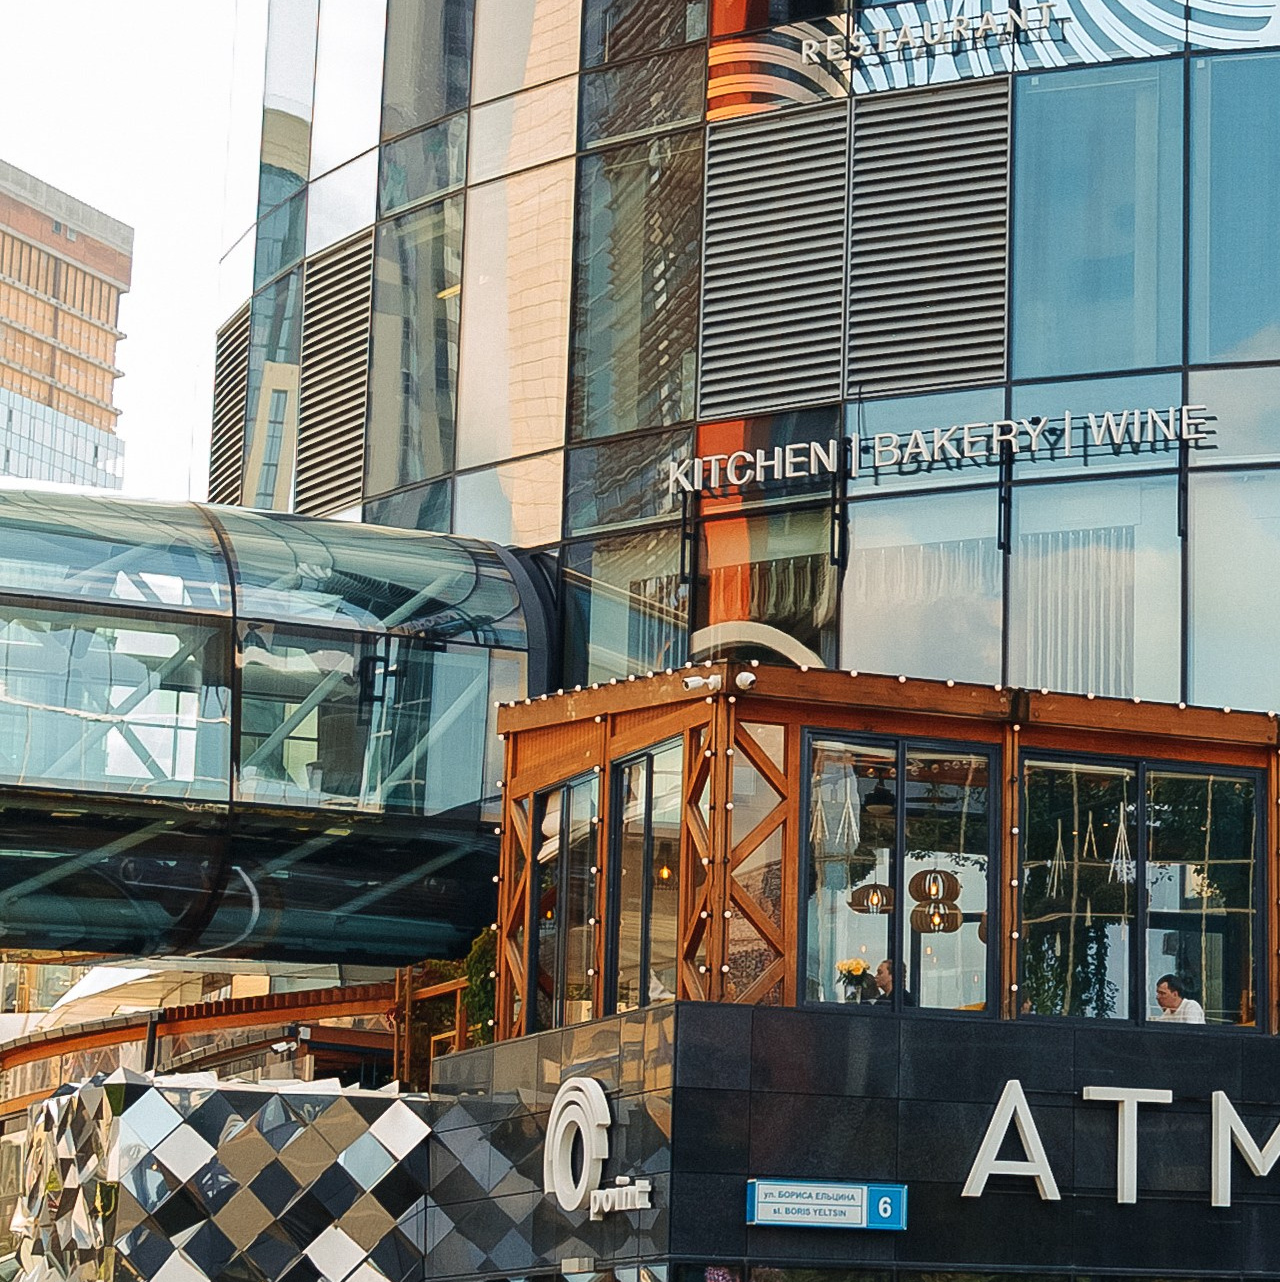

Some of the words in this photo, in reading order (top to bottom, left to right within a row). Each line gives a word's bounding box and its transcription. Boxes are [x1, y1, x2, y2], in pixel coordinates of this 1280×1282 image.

[801, 3, 1058, 65] RESTAURANT
[669, 439, 839, 494] KITCHEN
[874, 416, 1048, 467] BAKERY
[1088, 405, 1208, 445] WINE
[590, 1175, 652, 1221] point
[778, 1190, 813, 1200] БОРИСА
[815, 1192, 856, 1202] ЕЛЬЦИНА
[784, 1207, 811, 1216] BORIS
[812, 1208, 847, 1218] YELTSIN
[878, 1196, 892, 1219] 6
